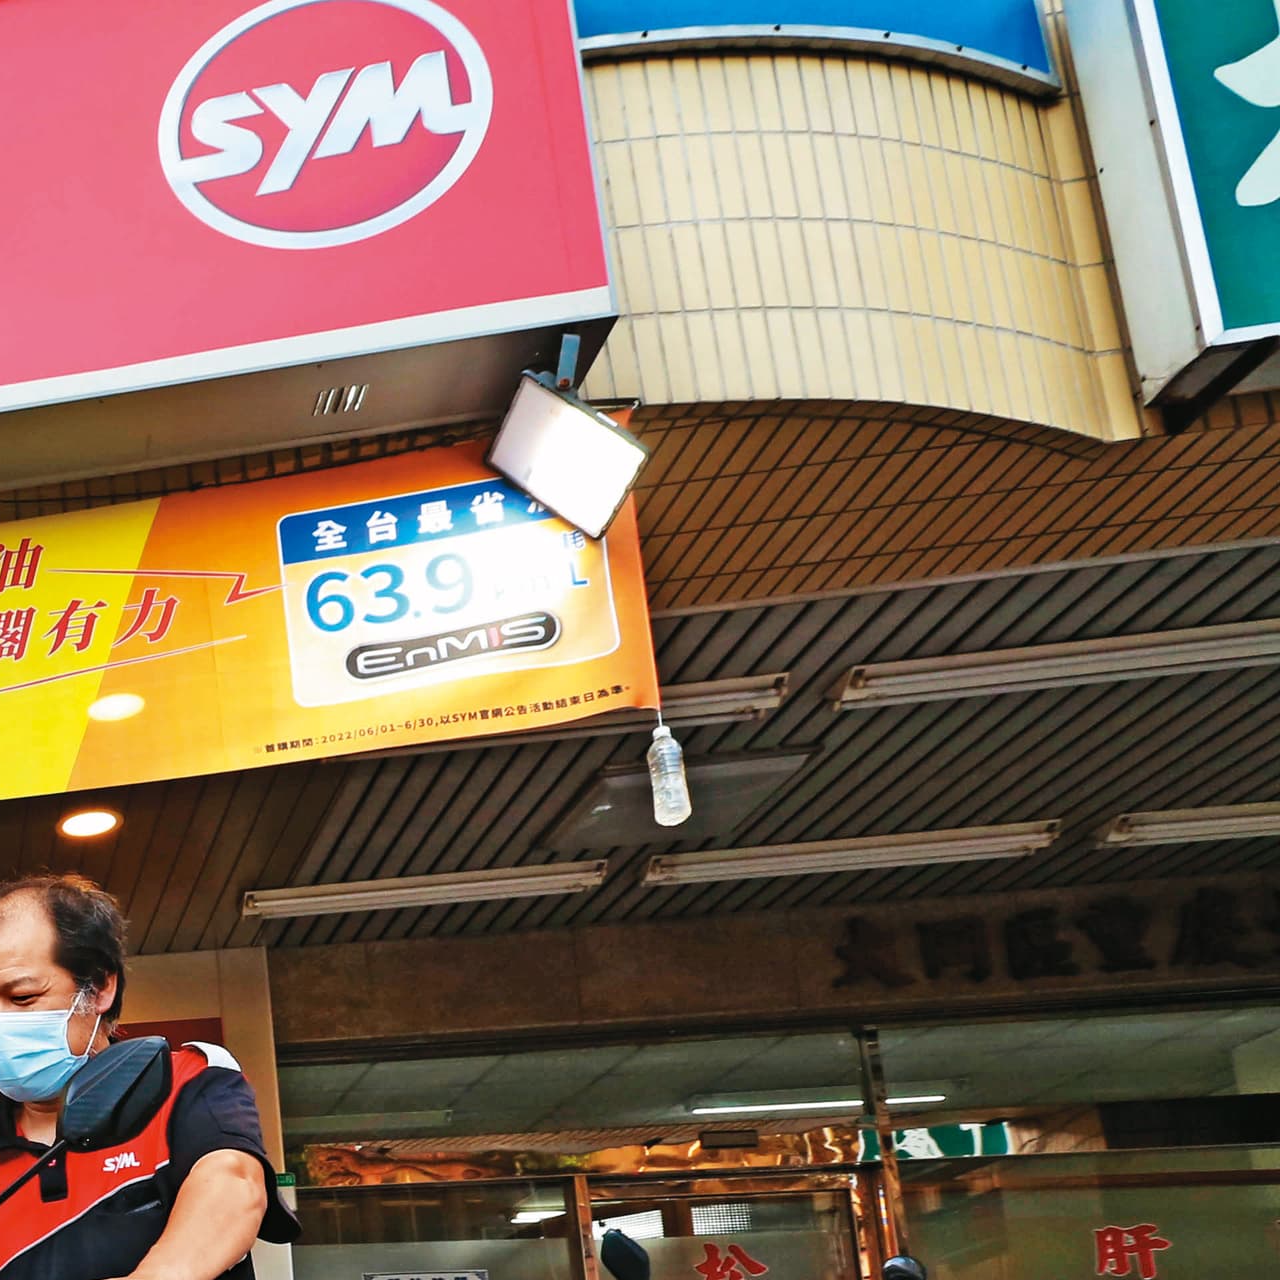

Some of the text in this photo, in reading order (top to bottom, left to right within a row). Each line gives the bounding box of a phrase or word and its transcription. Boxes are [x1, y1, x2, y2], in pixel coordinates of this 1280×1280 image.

[162, 50, 488, 196] SYM
[312, 491, 545, 552] 全台最省
[305, 552, 474, 633] 63.9
[102, 1151, 141, 1174] SYM
